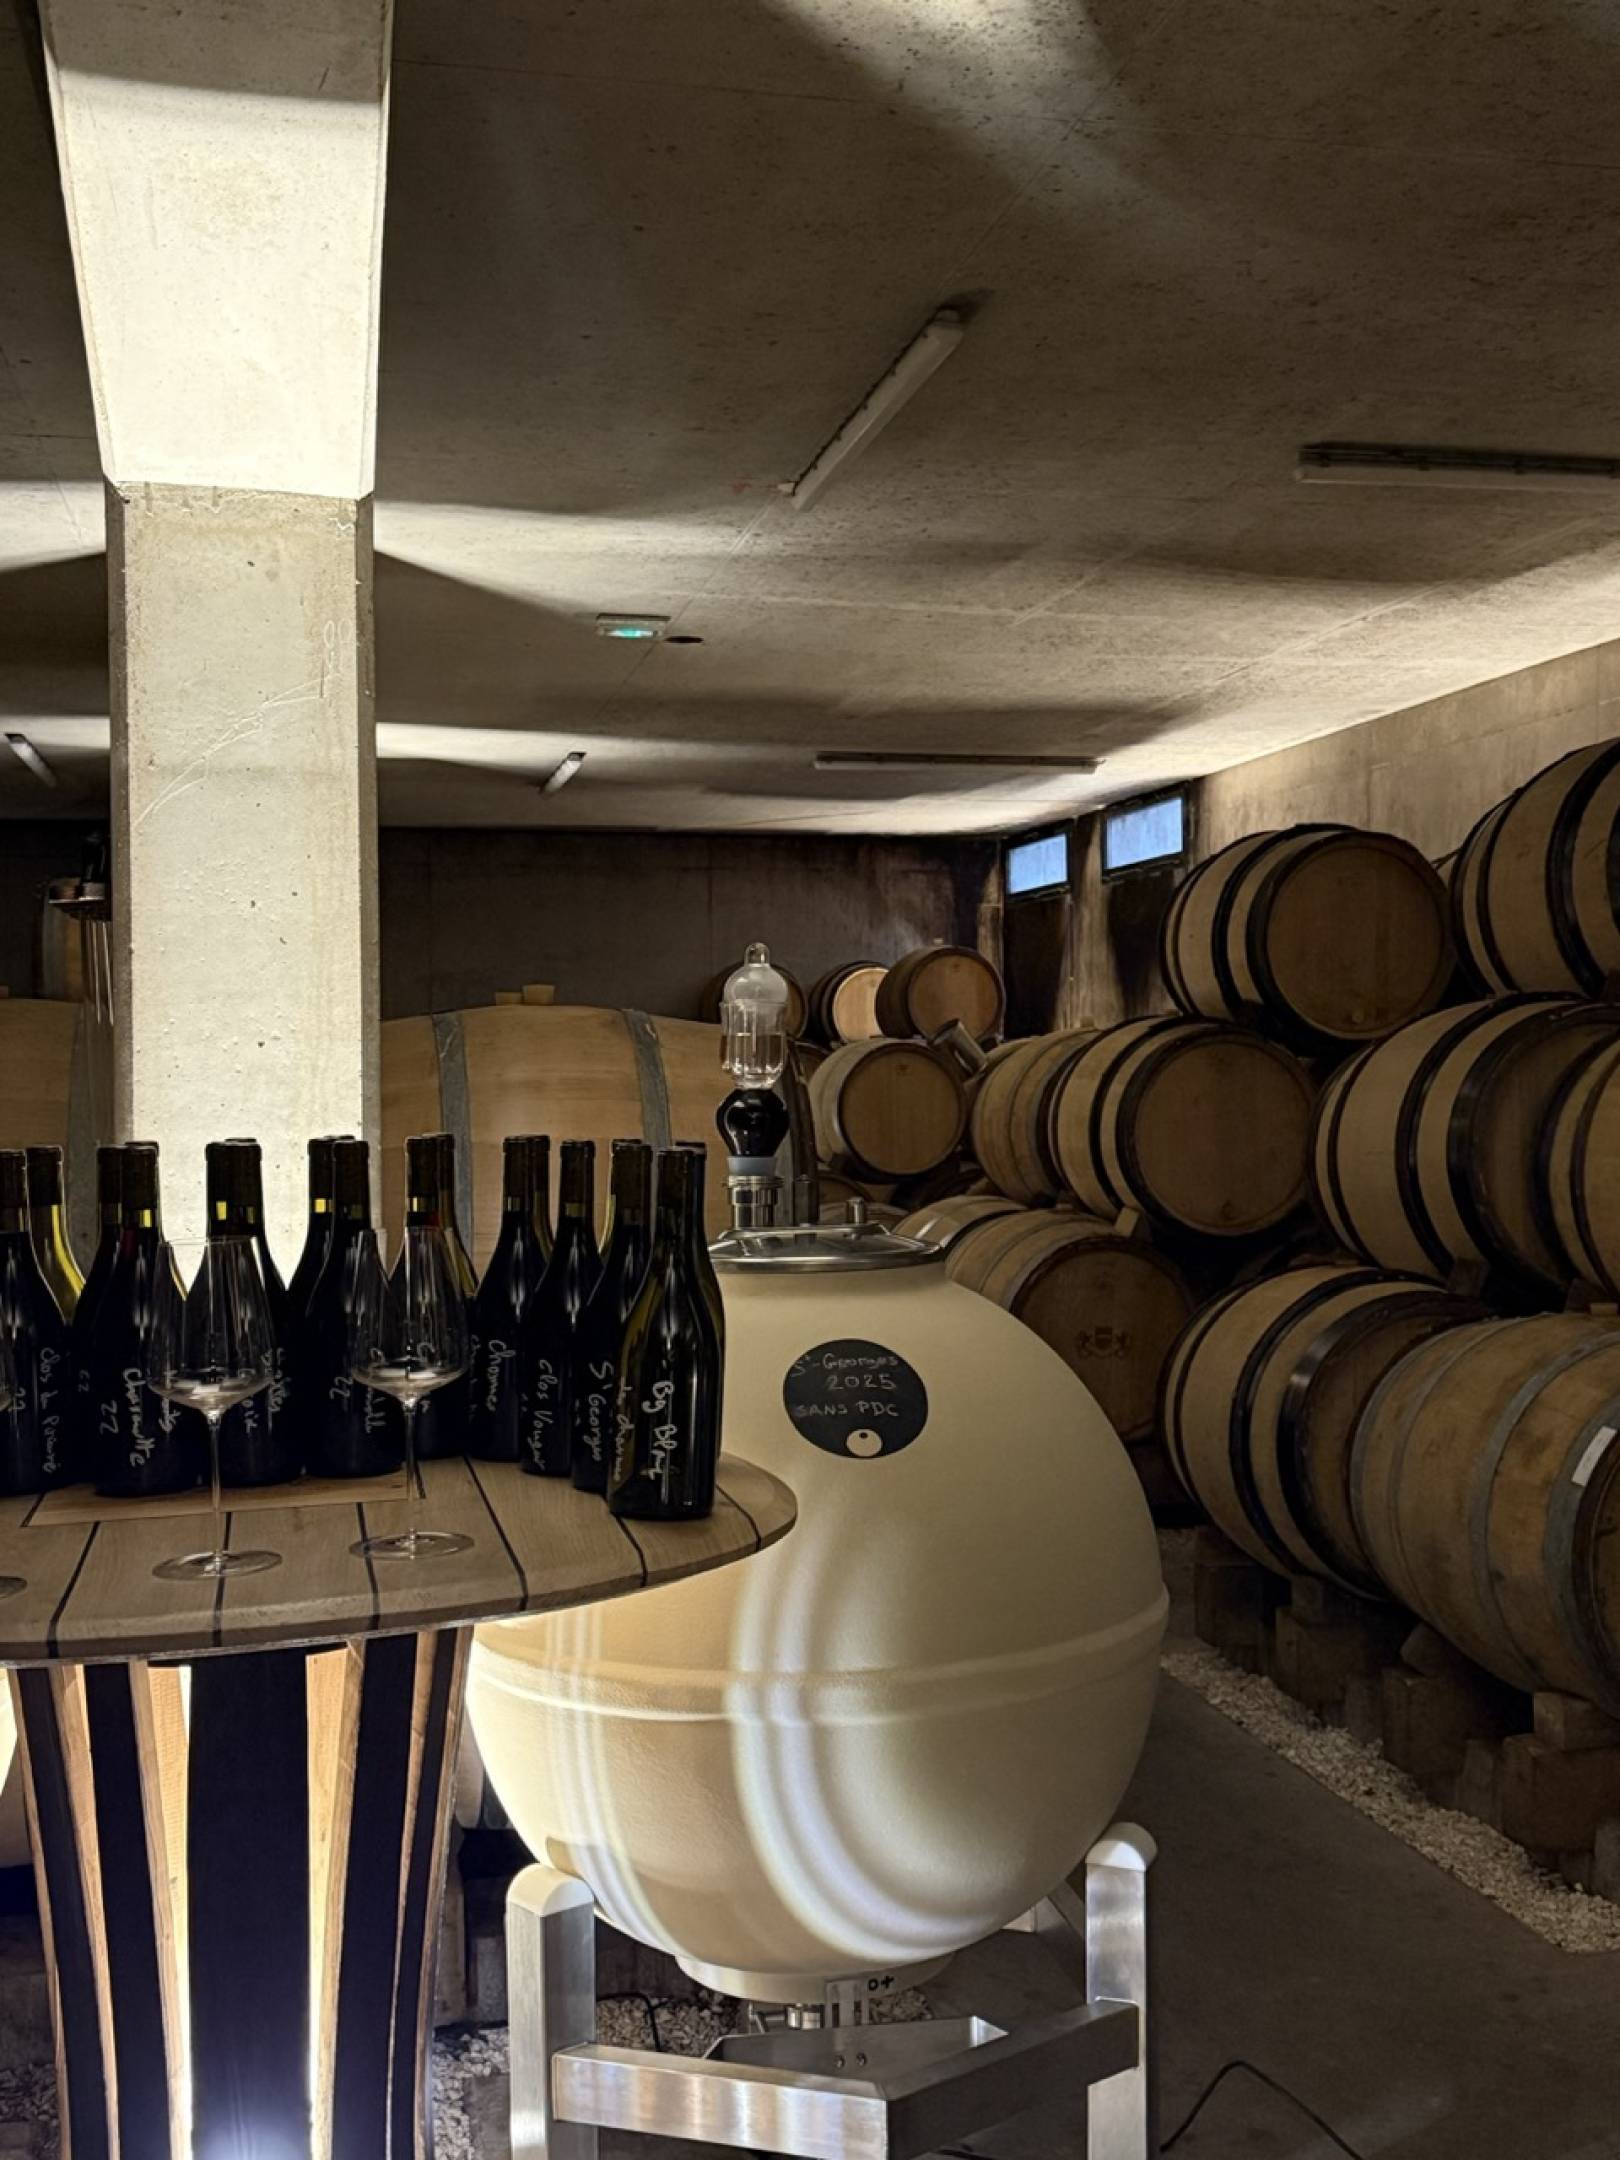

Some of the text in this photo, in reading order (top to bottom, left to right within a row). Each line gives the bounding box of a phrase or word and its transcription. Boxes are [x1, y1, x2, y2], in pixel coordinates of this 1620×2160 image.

[329, 1377, 353, 1400] 22
[537, 1358, 558, 1400] Clos
[825, 1373, 898, 1391] 2025
[98, 1400, 119, 1436] 22
[794, 1399, 900, 1418] SANS PDC
